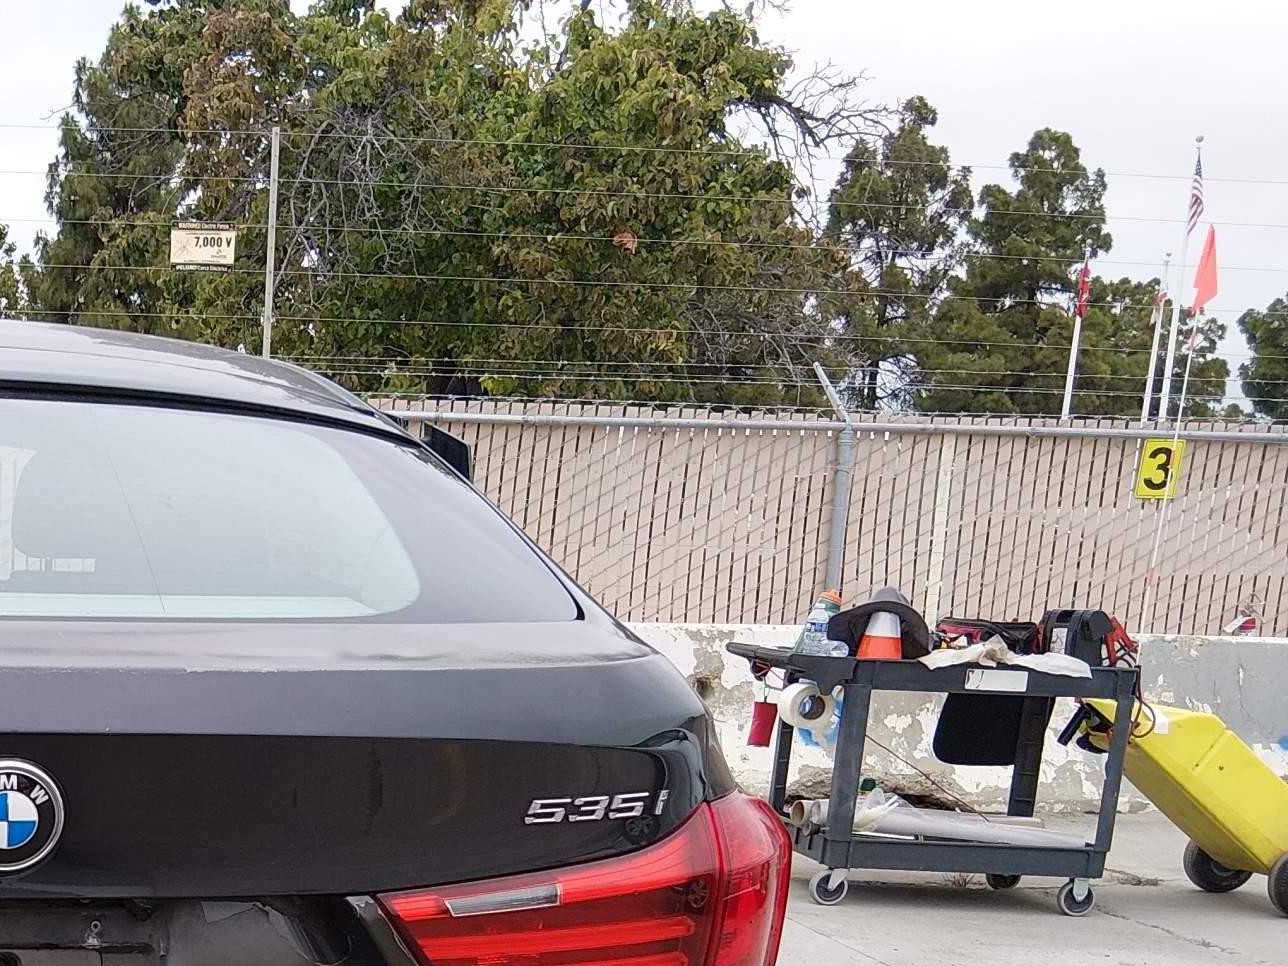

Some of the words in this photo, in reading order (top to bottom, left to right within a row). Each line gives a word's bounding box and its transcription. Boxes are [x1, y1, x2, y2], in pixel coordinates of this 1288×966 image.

[194, 236, 223, 248] 7,000
[225, 237, 232, 248] V
[1143, 446, 1174, 491] 3
[524, 789, 670, 825] 535i
